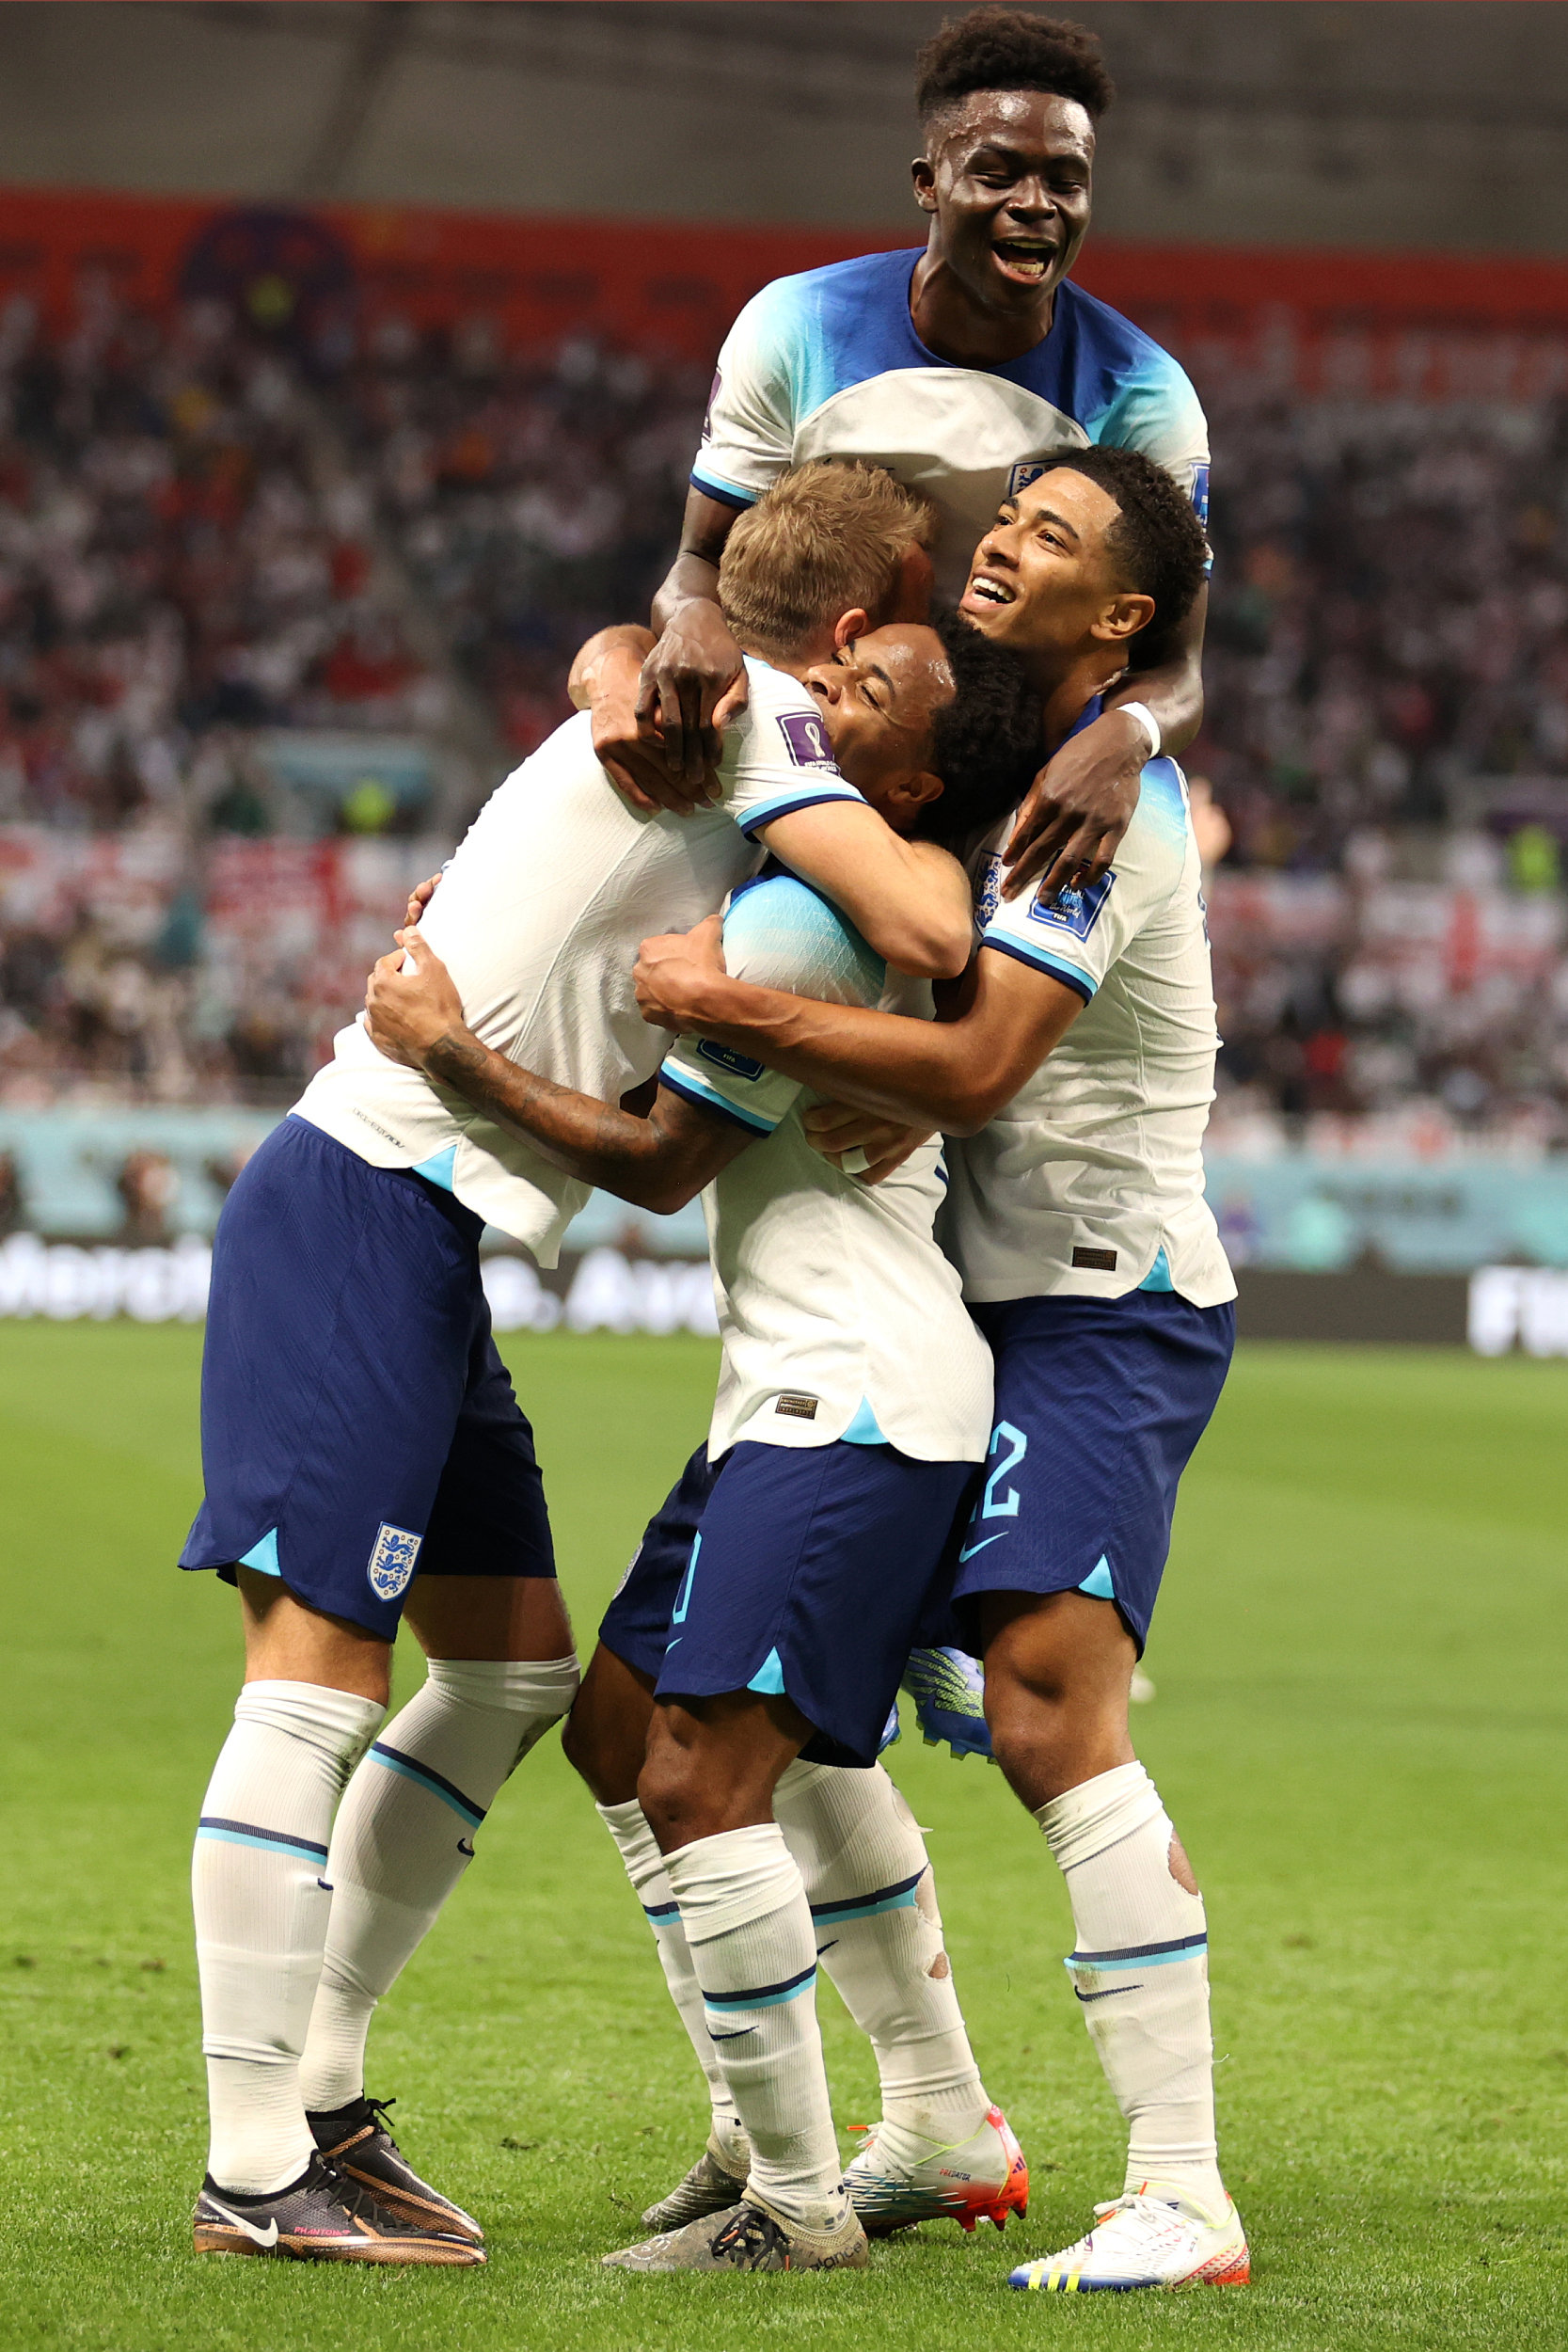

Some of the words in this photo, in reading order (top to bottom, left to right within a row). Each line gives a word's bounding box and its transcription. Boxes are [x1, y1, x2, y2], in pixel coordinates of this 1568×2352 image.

[1053, 914, 1068, 922] FIFA
[973, 1420, 1027, 1519] 2
[939, 2168, 972, 2182] PREDATOR
[809, 2241, 863, 2272] alance
